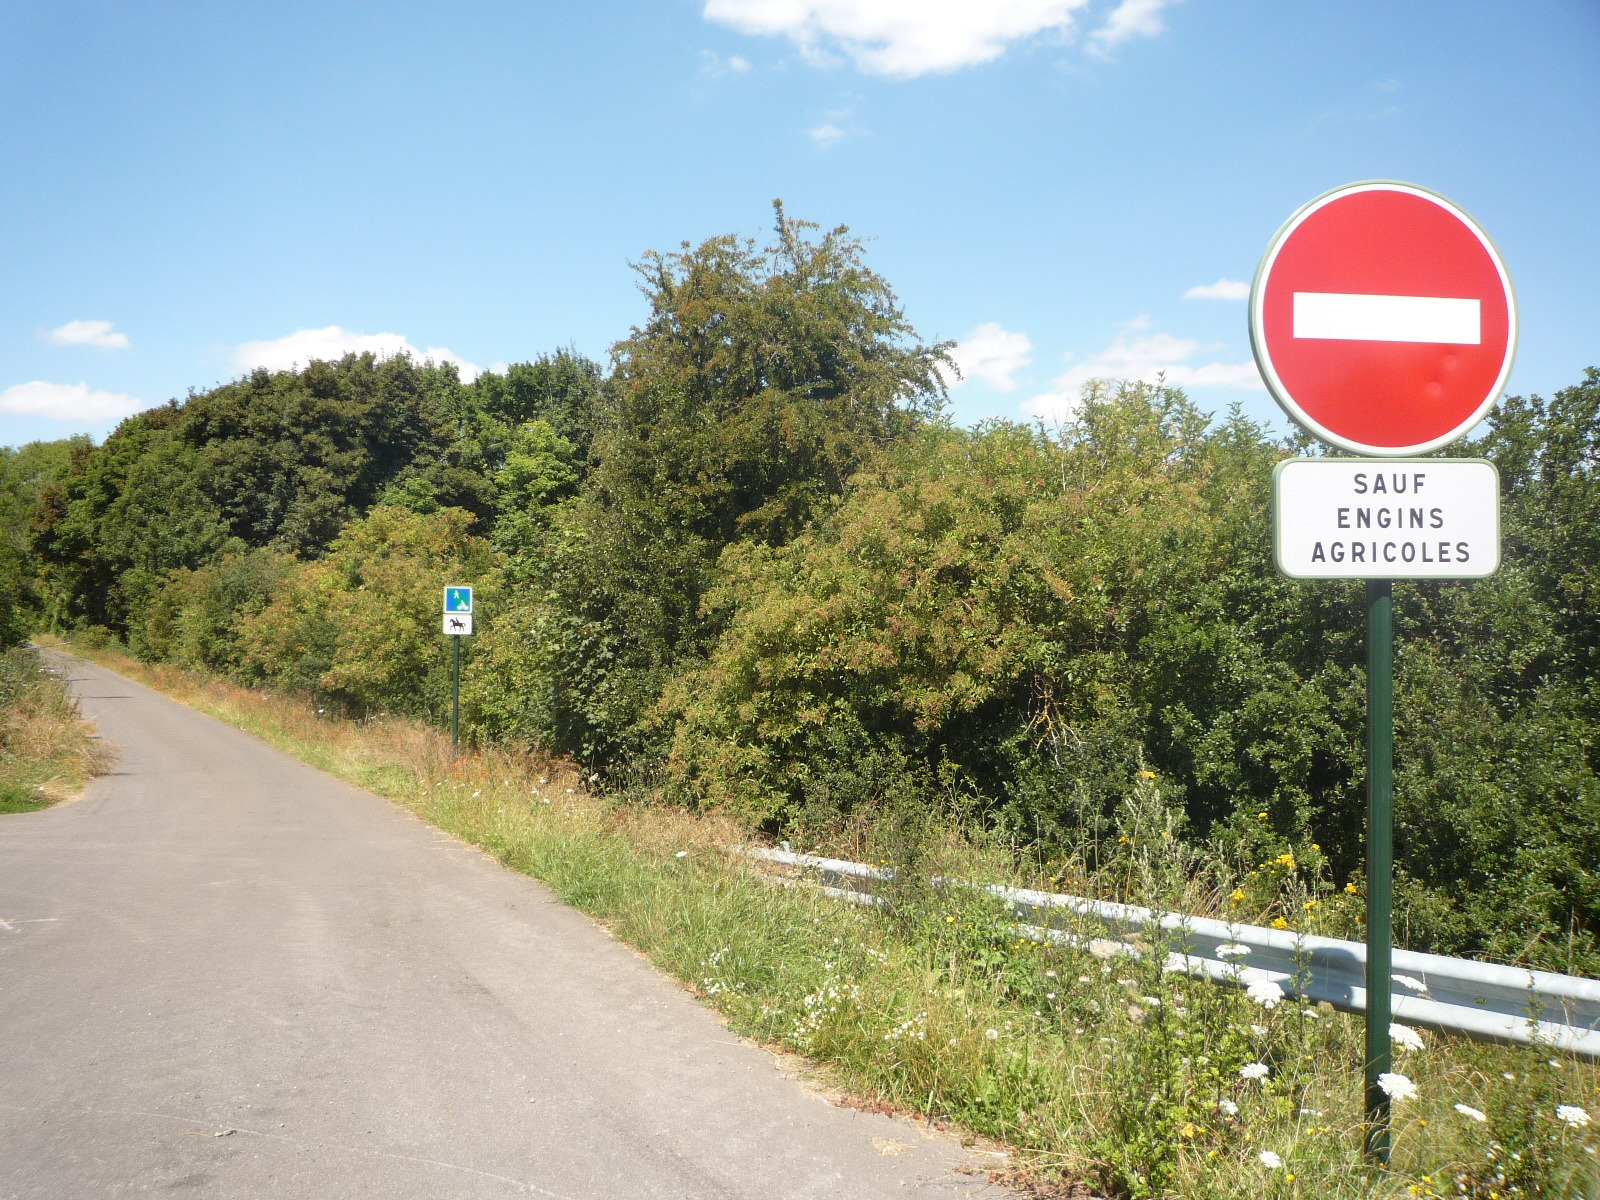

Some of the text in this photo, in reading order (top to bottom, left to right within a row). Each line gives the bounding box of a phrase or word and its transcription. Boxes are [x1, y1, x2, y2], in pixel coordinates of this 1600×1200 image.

[1354, 473, 1426, 494] SAUF
[1338, 508, 1443, 529] ENGINS
[1311, 542, 1470, 563] AGRICOLES
